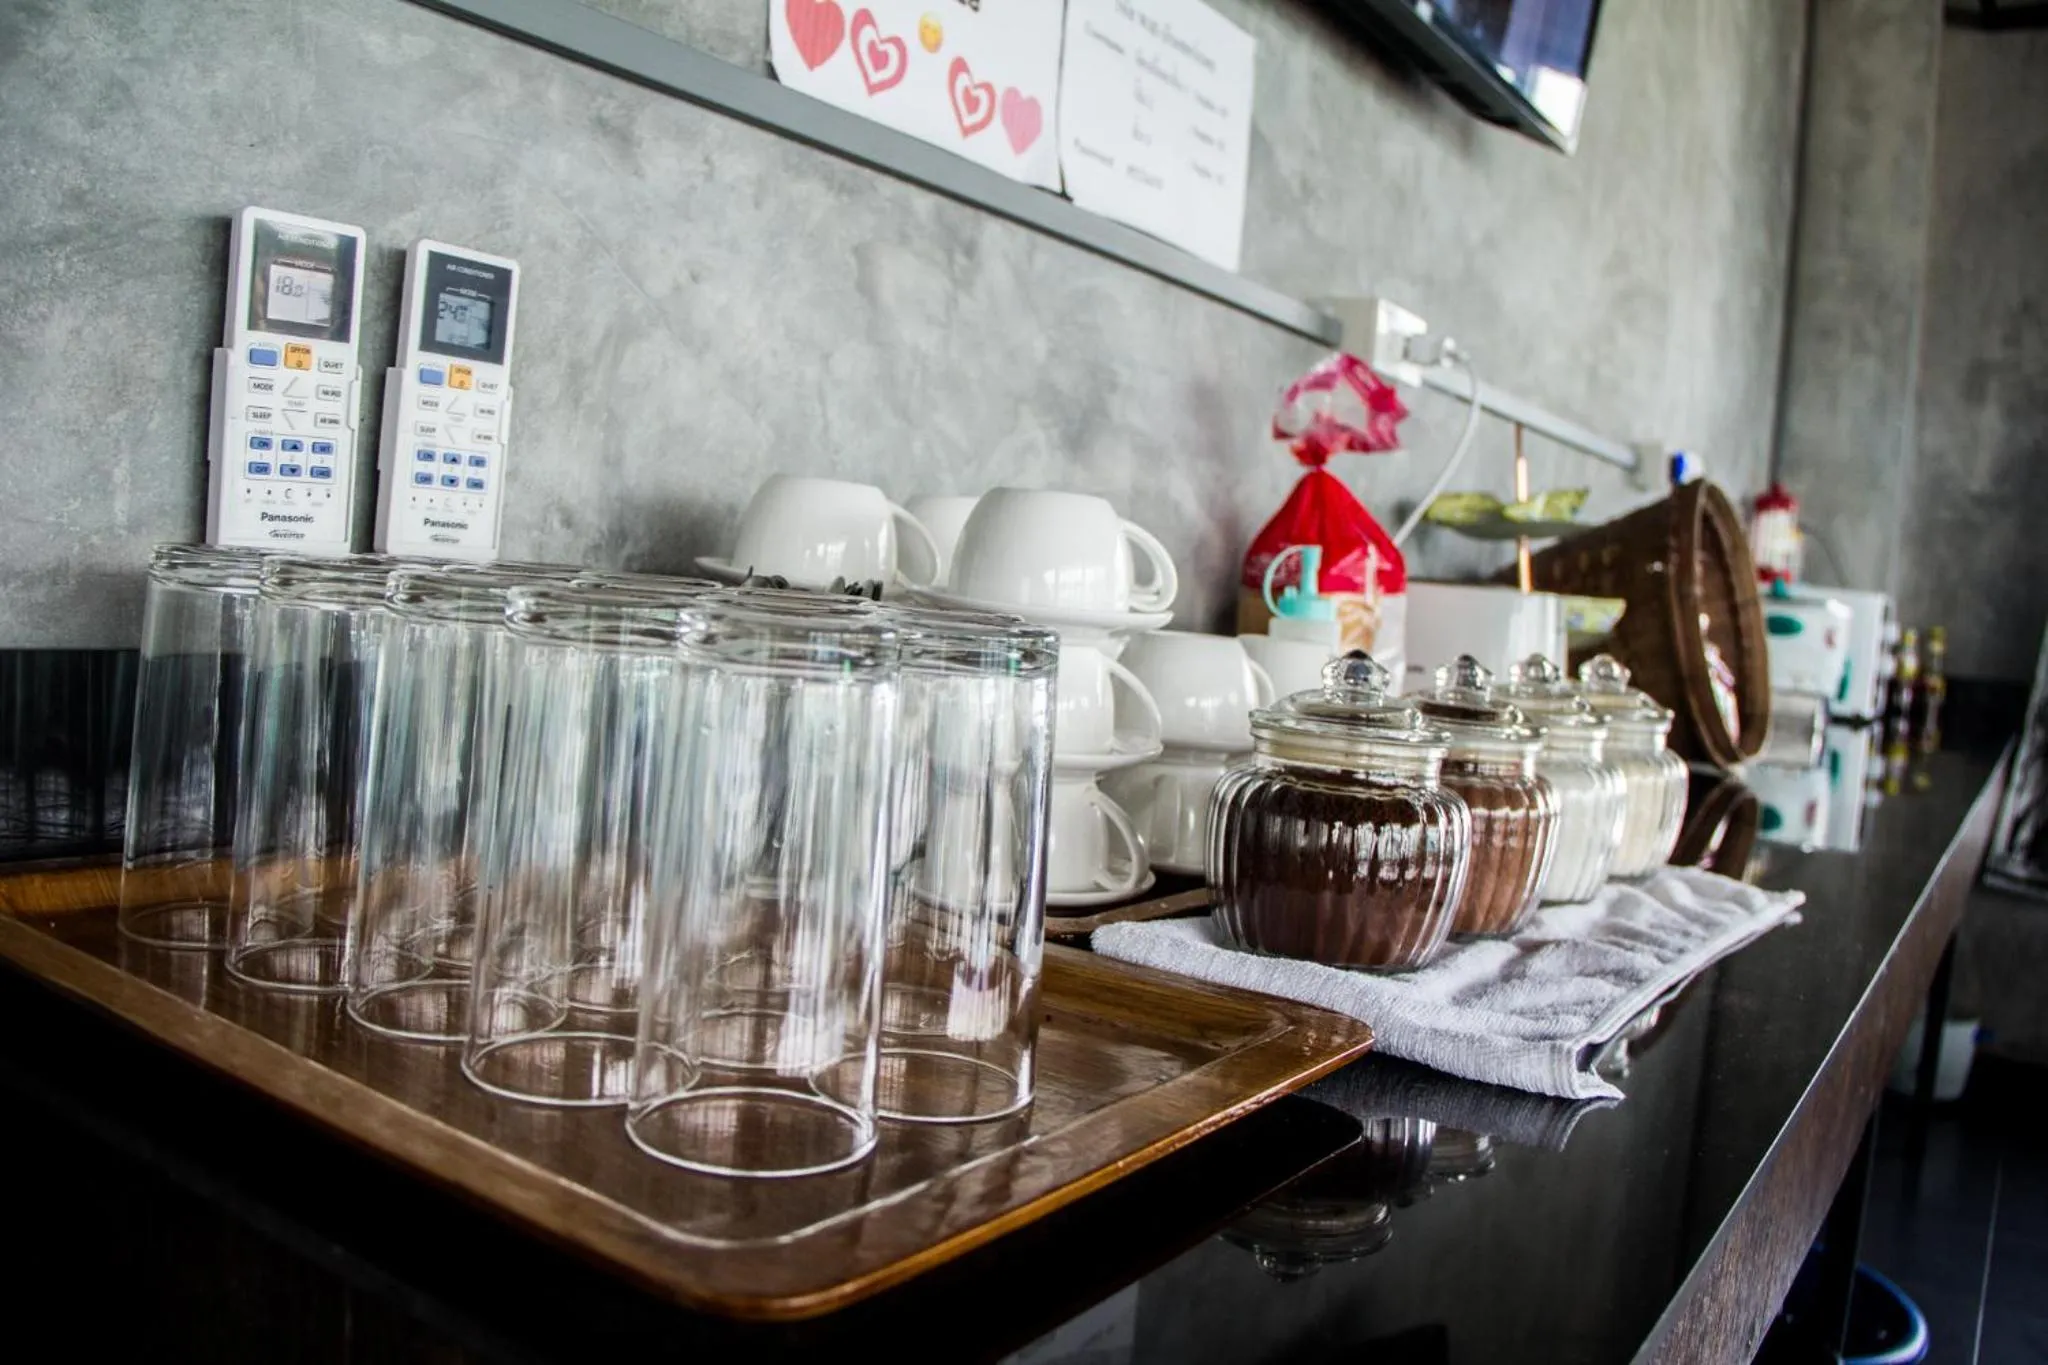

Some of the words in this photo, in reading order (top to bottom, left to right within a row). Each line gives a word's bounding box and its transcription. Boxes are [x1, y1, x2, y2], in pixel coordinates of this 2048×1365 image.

[323, 361, 344, 369] QUIET
[253, 383, 274, 391] MODE
[261, 512, 316, 524] Panasonic
[424, 518, 469, 530] Panasonic
